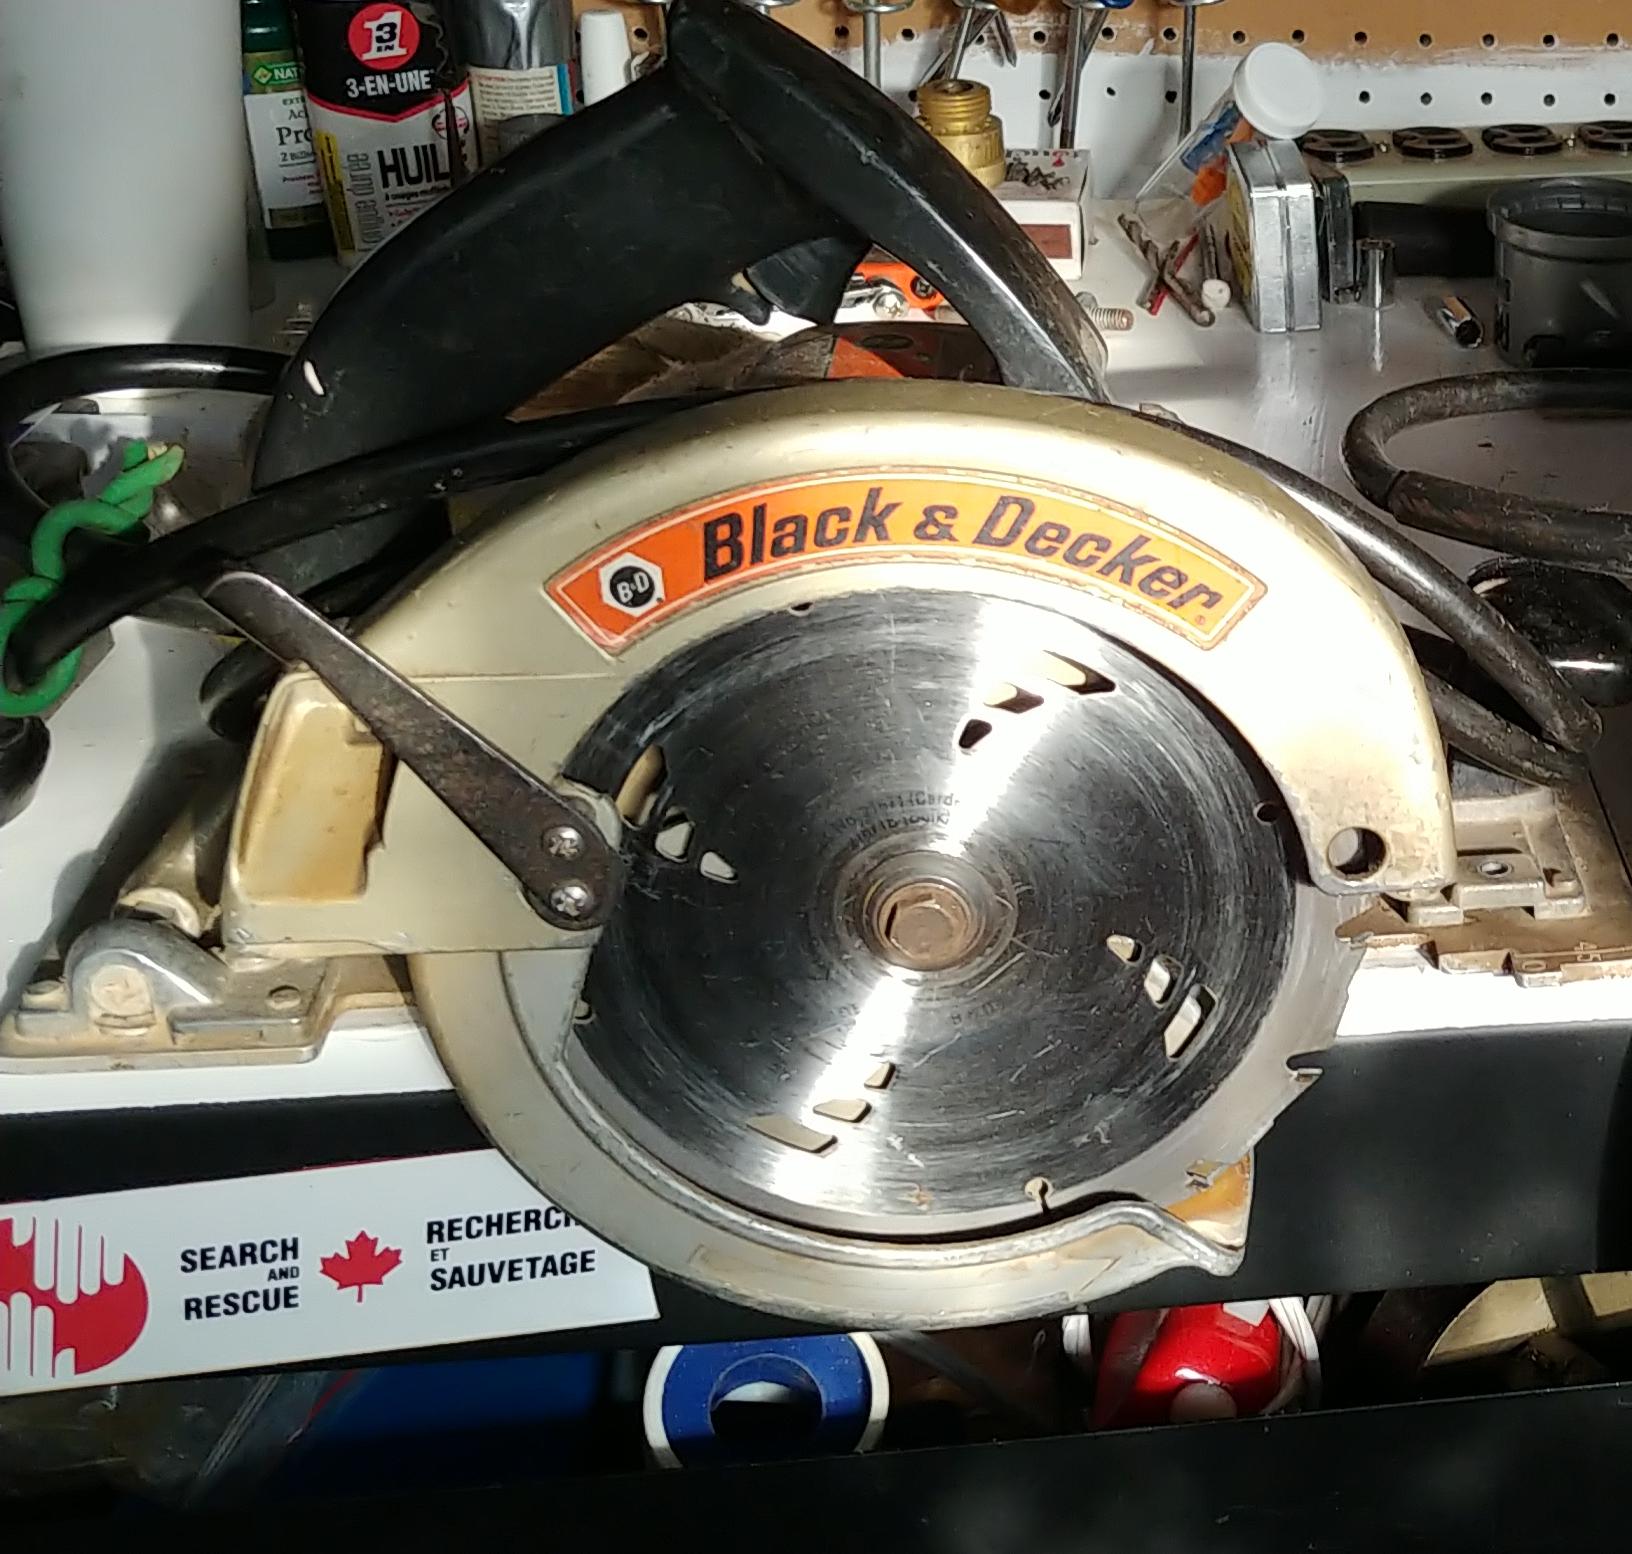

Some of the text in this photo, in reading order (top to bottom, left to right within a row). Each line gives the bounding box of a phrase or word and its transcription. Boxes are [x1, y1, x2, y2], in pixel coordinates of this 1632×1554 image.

[346, 69, 432, 98] 3-EN-UNE
[704, 487, 1223, 610] Black & Decker
[180, 1237, 299, 1273] SEARCH
[430, 1248, 450, 1262] ET
[430, 1249, 596, 1291] SAUVETAGE
[267, 1265, 300, 1282] AND
[184, 1285, 299, 1321] RESCUE
